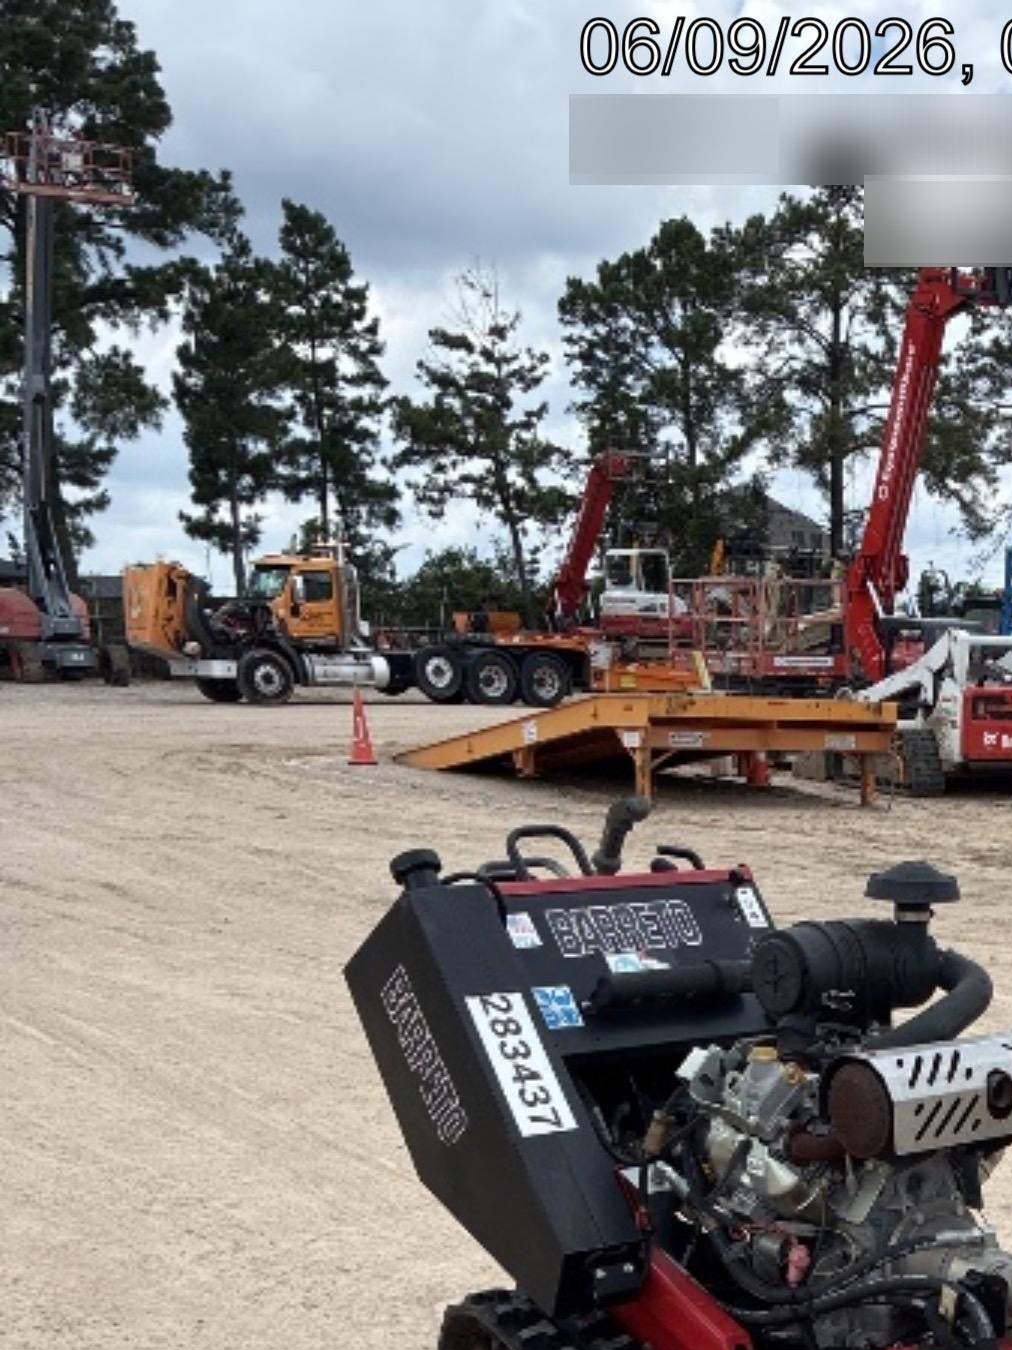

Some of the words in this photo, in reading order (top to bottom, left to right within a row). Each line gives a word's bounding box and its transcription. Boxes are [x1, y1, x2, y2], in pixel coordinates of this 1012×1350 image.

[546, 899, 703, 959] BARRETO
[380, 963, 469, 1147] BARRETO
[479, 993, 565, 1130] 283437
